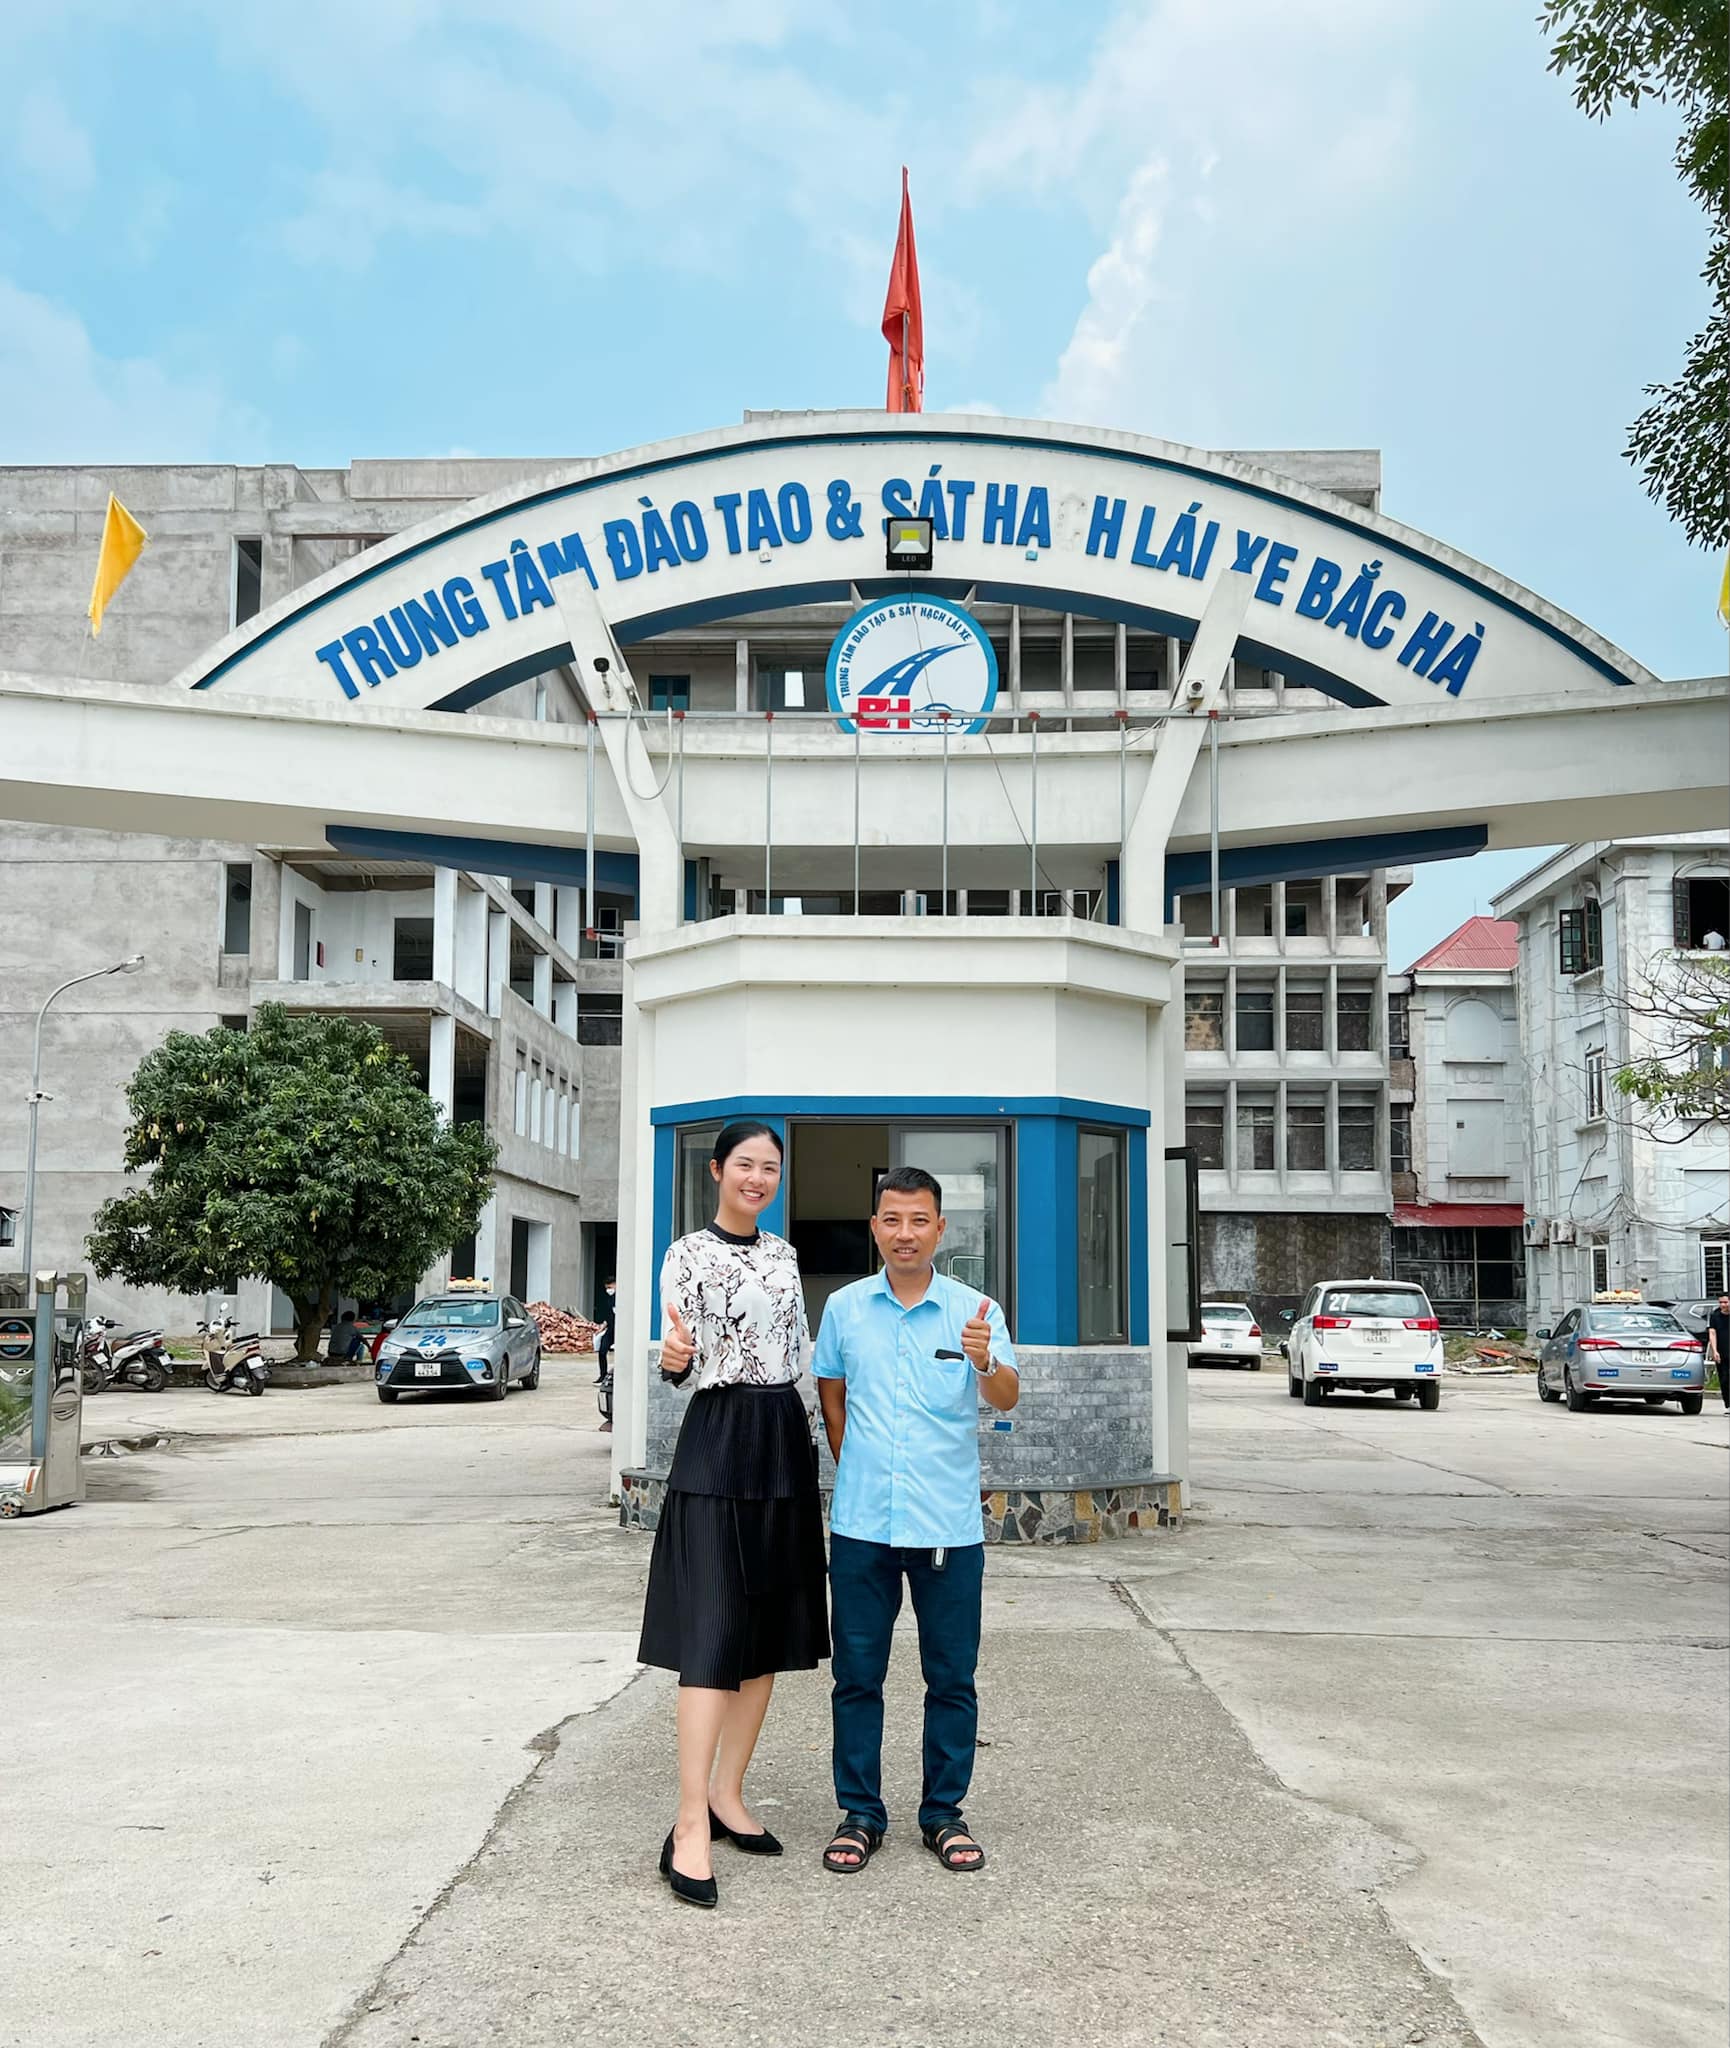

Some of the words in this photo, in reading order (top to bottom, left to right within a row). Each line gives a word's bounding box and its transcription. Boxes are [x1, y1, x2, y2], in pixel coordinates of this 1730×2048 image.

[316, 576, 489, 700] TRUNG
[480, 538, 600, 621] TÂM
[602, 496, 710, 582] ĐÀO
[825, 479, 866, 541] &
[880, 463, 977, 541] SÁT
[1131, 501, 1221, 581] LÁI
[1229, 528, 1299, 607] XE
[1295, 558, 1407, 650] BẮC
[1397, 610, 1486, 697] HÀ
[889, 609, 897, 619] &
[898, 602, 917, 617] SÁT
[920, 607, 947, 623] HẠCH
[868, 612, 887, 628] TẠO
[945, 617, 962, 632] LÁI
[851, 625, 870, 644] ĐÀO
[958, 629, 973, 642] XE
[841, 643, 857, 664] TÂM
[839, 666, 851, 698] TRUNG
[858, 698, 911, 729] BH
[1328, 1293, 1351, 1312] 27
[1622, 1316, 1652, 1328] 25
[417, 1334, 448, 1347] 24
